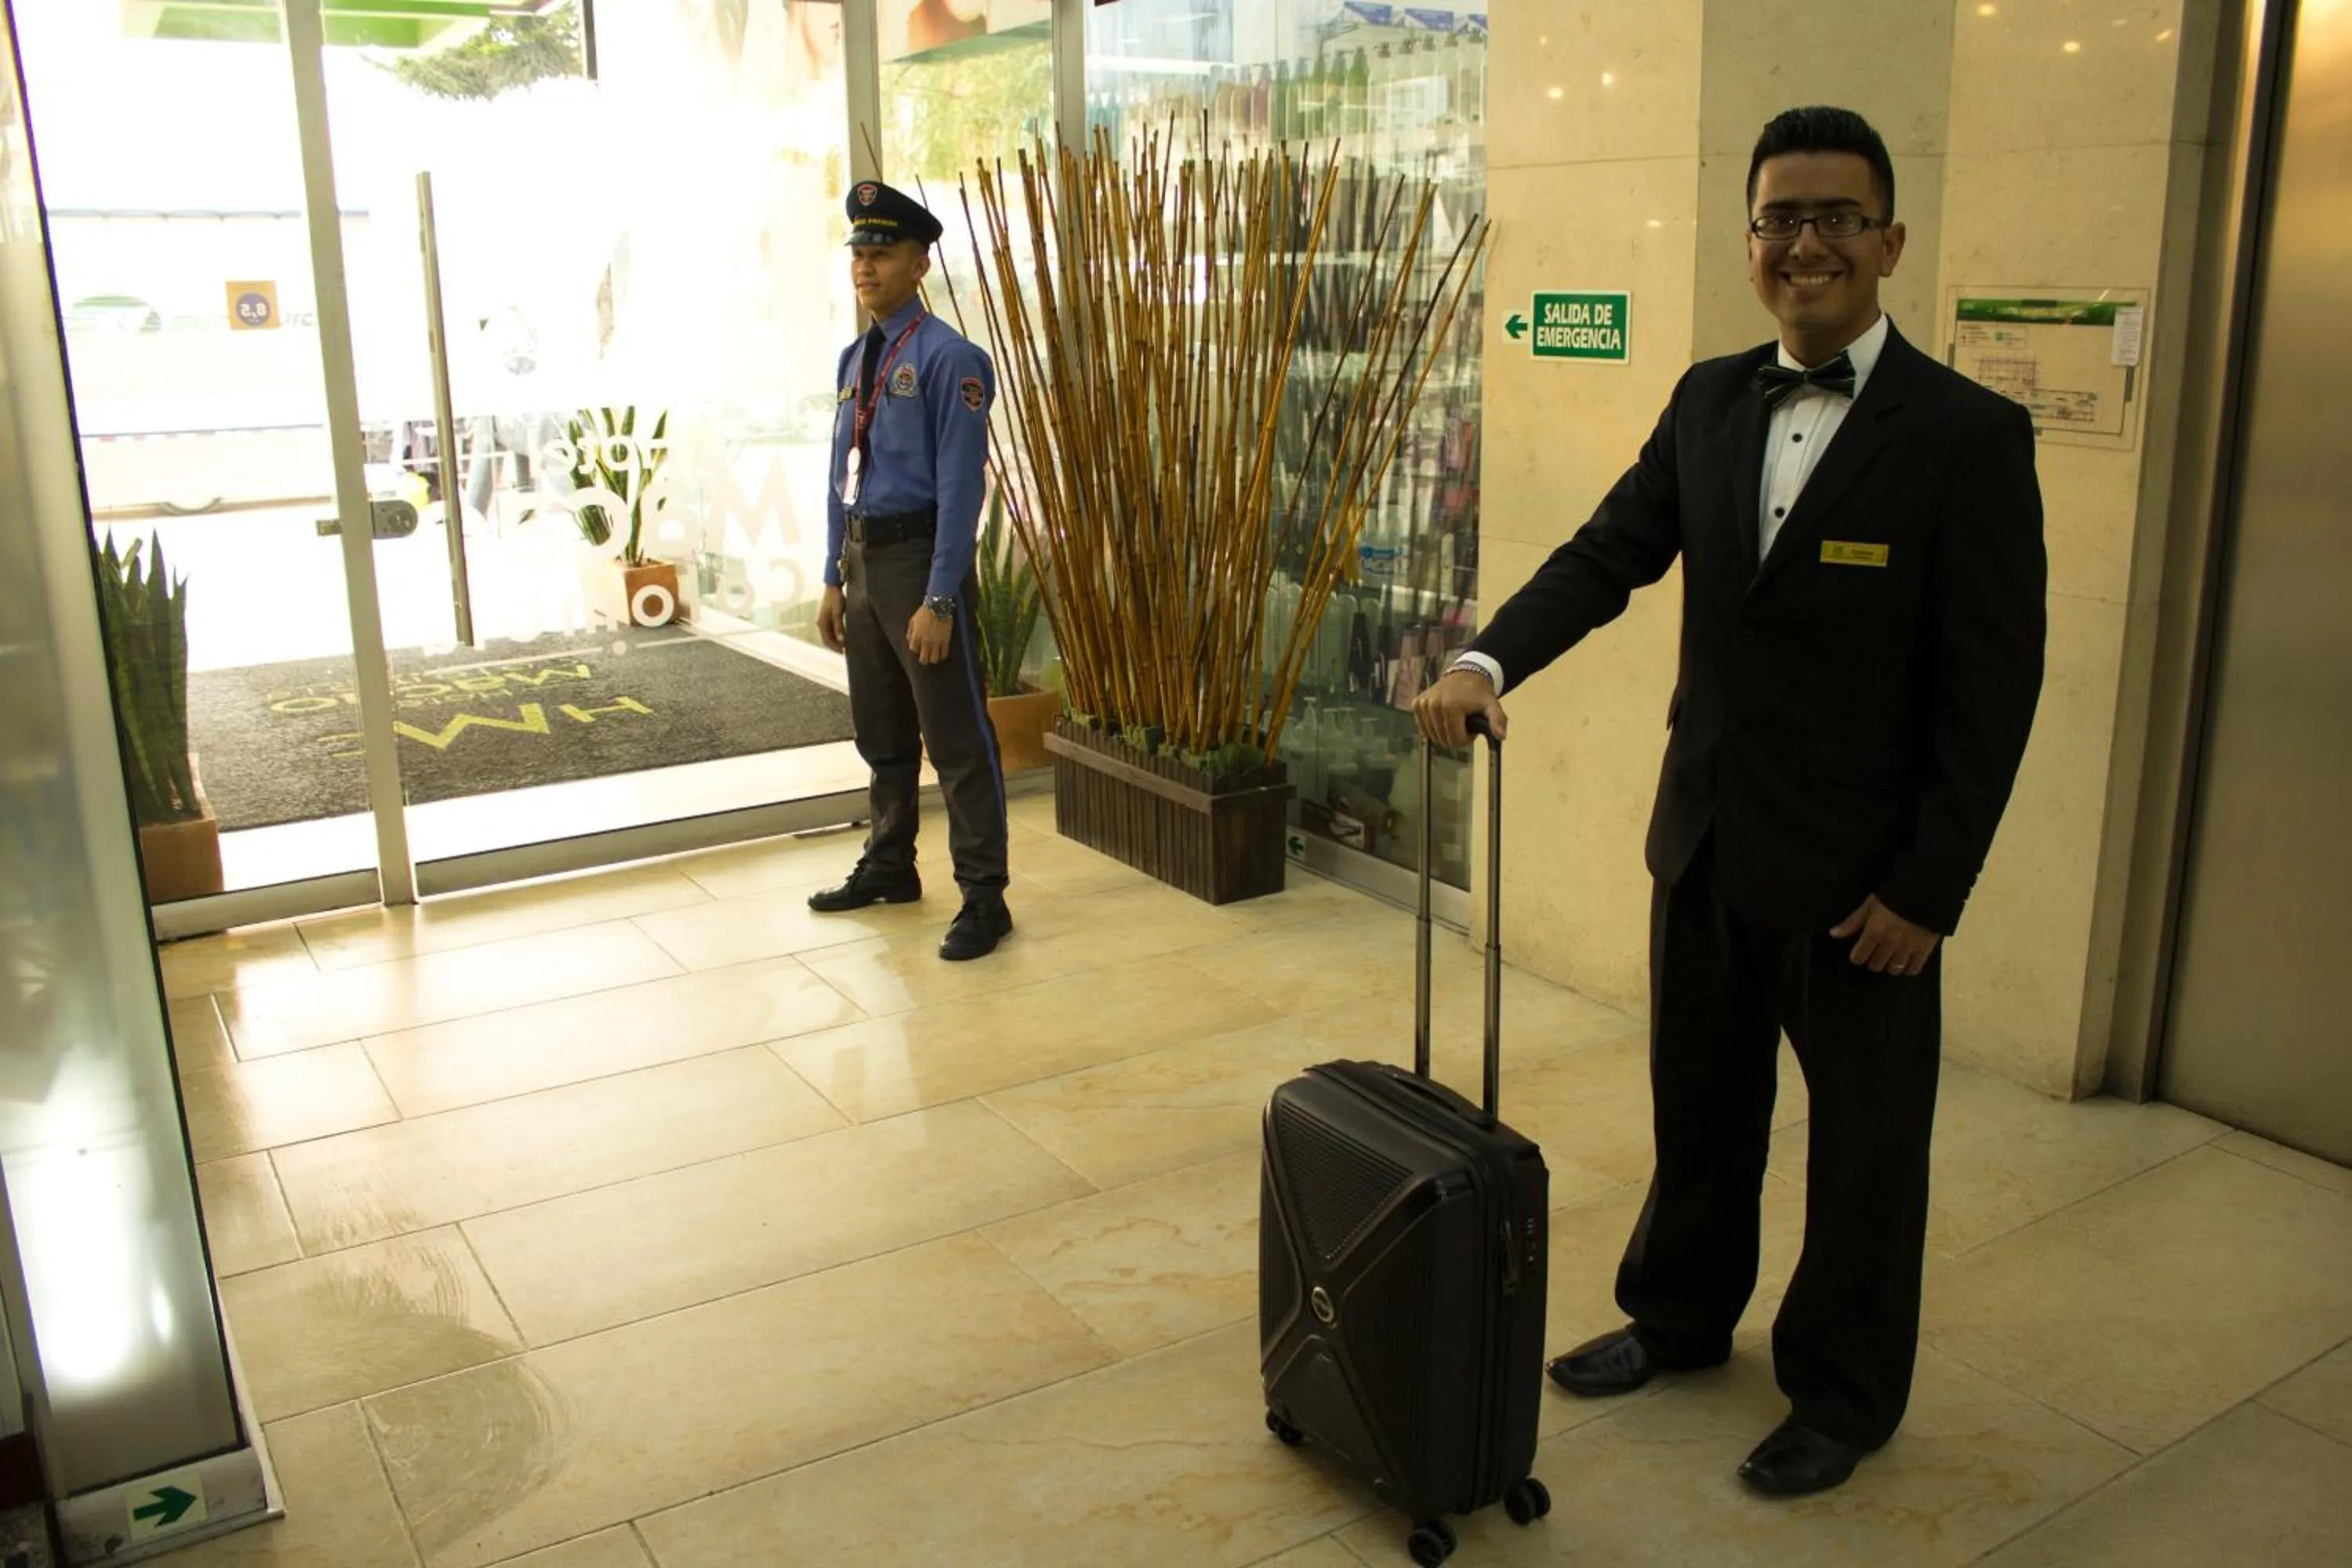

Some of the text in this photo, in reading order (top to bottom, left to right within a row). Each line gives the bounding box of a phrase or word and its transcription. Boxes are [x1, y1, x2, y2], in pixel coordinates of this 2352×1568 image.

[1544, 303, 1613, 325] SALIDA DE
[1537, 326, 1621, 350] EMERGENCIA
